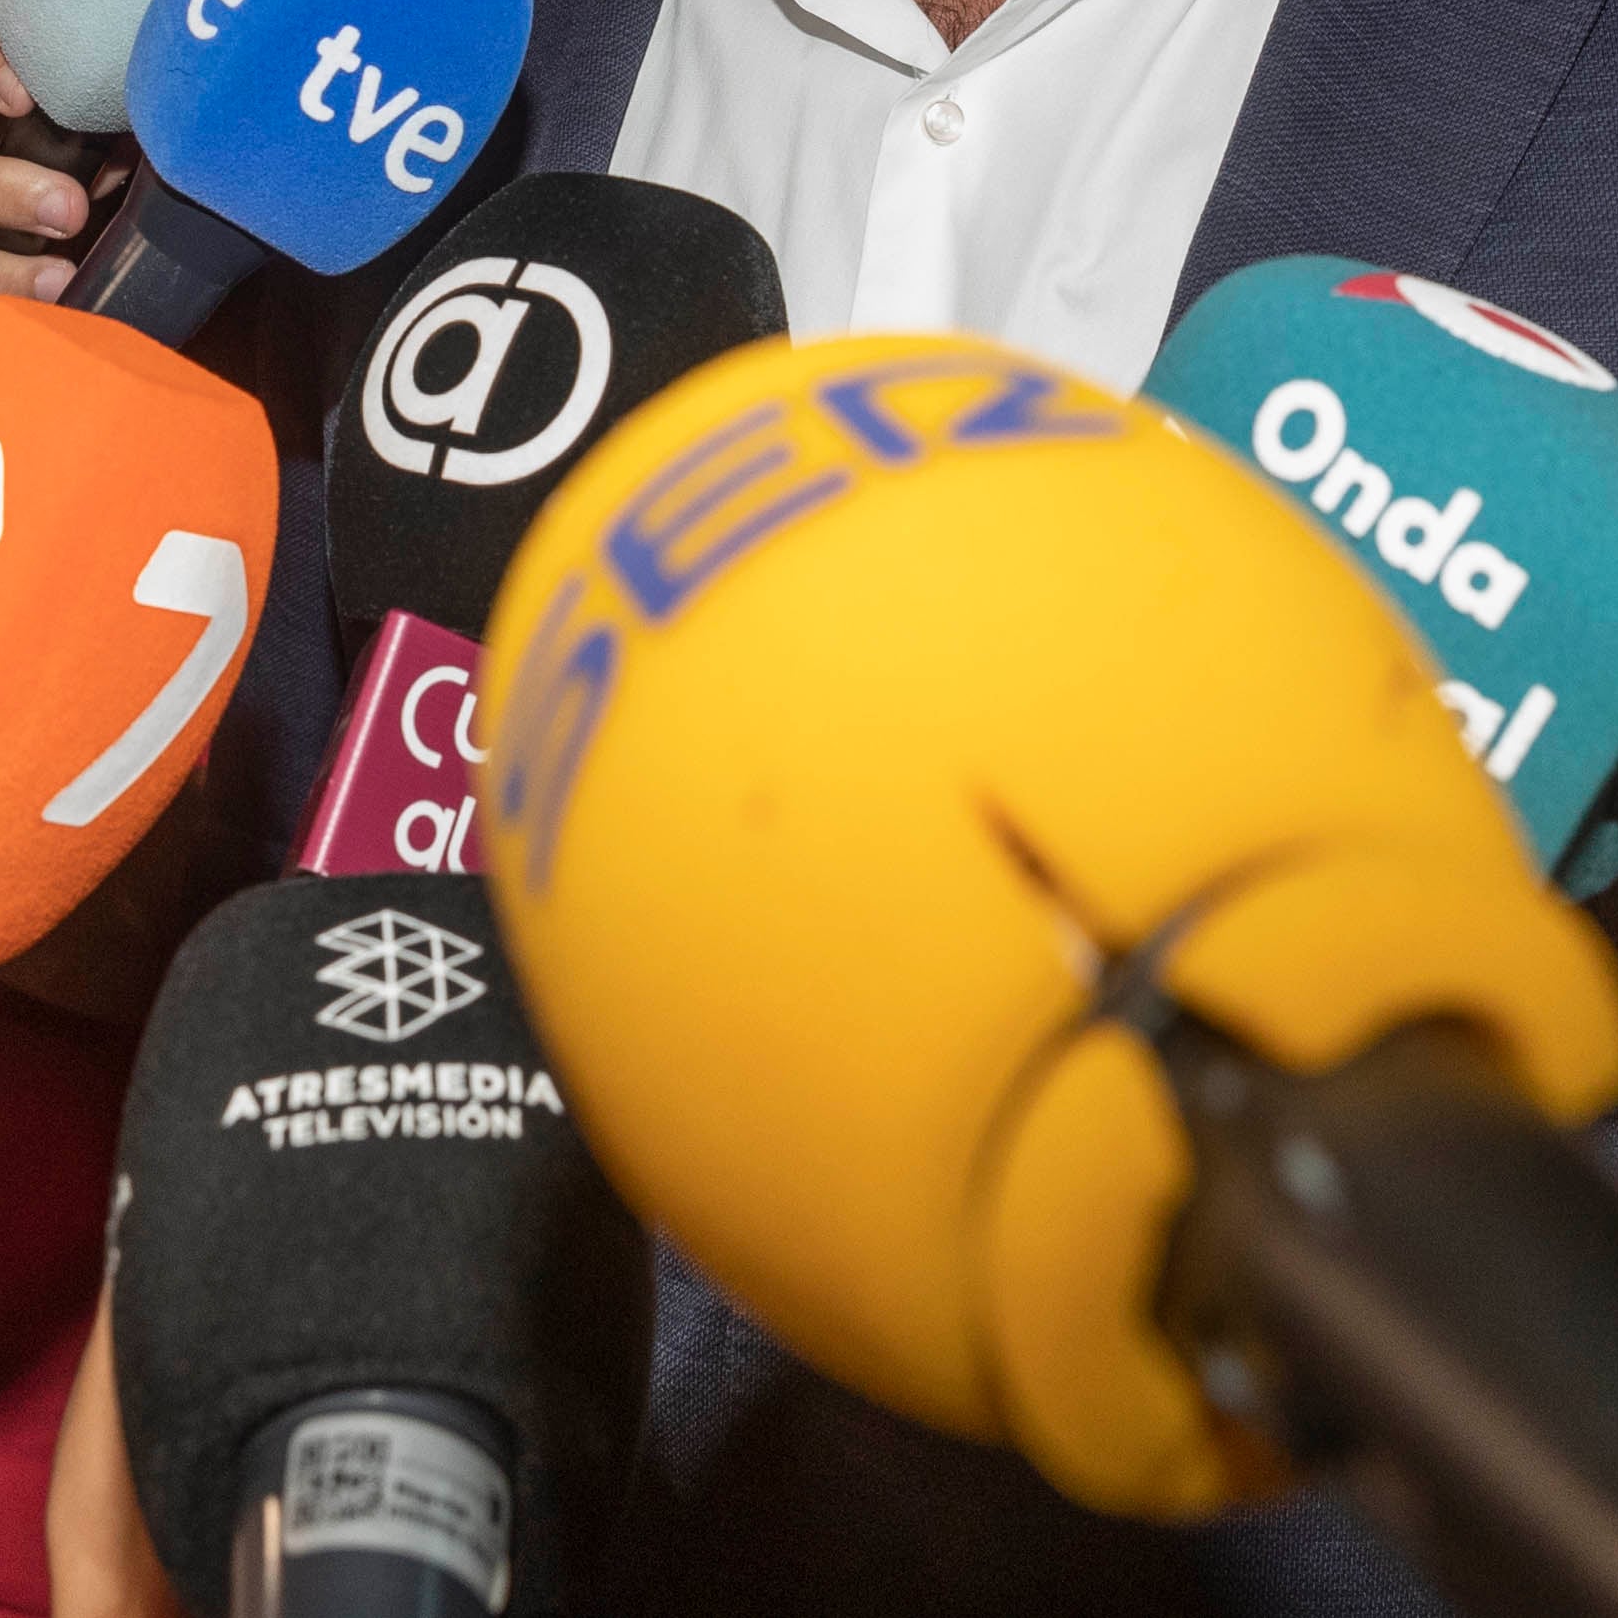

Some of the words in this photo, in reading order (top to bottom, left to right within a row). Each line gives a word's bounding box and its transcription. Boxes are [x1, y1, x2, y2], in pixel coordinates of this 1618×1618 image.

[299, 24, 464, 194] tve
[1252, 379, 1530, 631] Onda
[41, 529, 249, 827] 7
[220, 1061, 564, 1129] ATRESMEDIA
[263, 1096, 524, 1151] TELEVISIÓN
